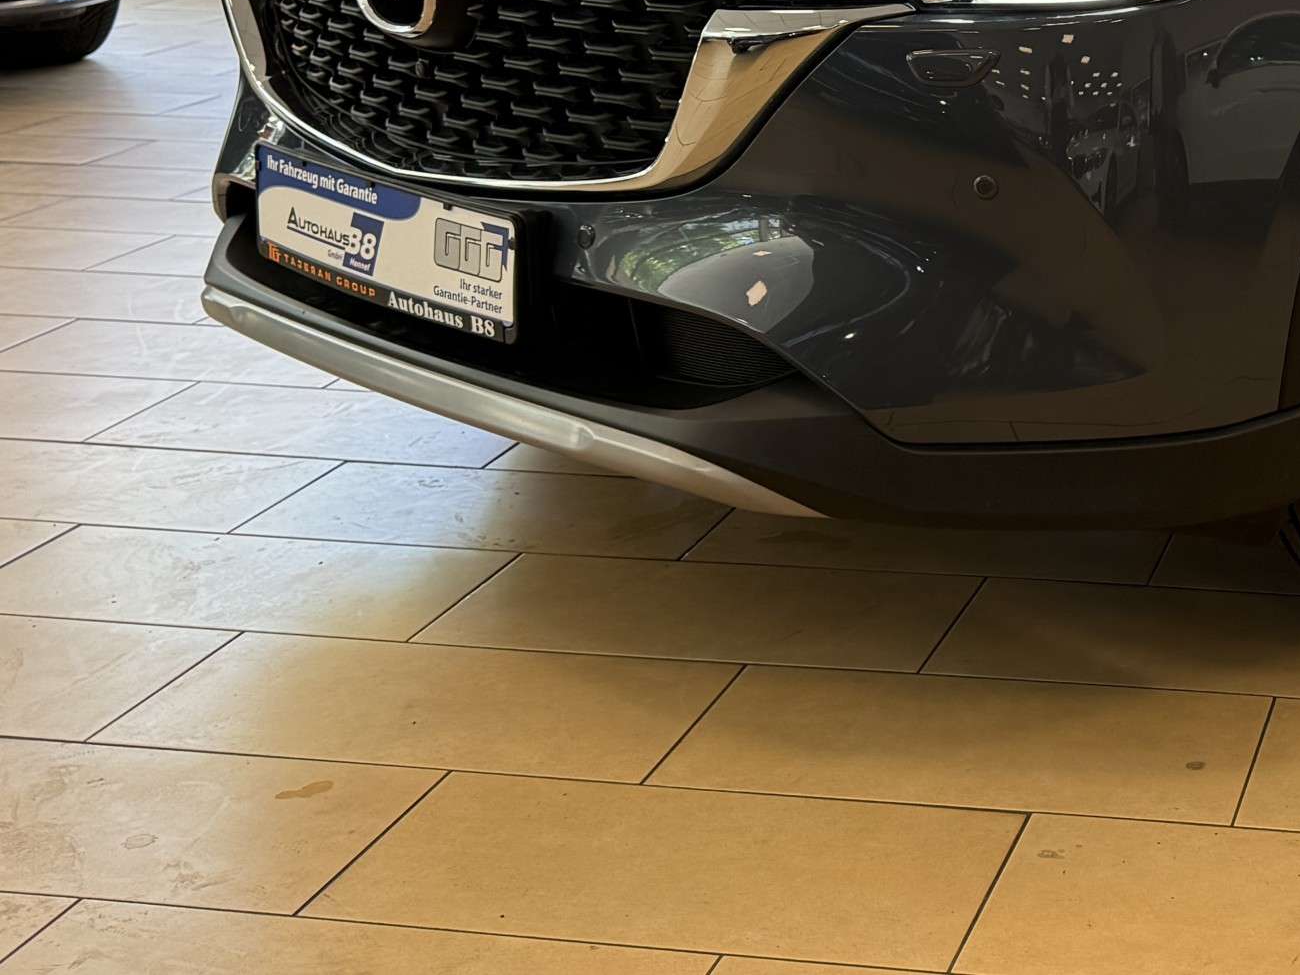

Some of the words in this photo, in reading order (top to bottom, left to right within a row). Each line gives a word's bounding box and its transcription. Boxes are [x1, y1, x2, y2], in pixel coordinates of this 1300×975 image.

[267, 154, 279, 171] Ihr
[279, 159, 319, 189] Fahrzeug
[319, 174, 336, 191] mit
[336, 178, 378, 205] Garantie
[335, 276, 376, 297] GROUP
[433, 285, 503, 314] Garantie-Partner
[460, 278, 472, 292] Ihr
[473, 283, 503, 300] starker
[387, 290, 464, 329] Autohaus
[470, 315, 496, 338] B8
